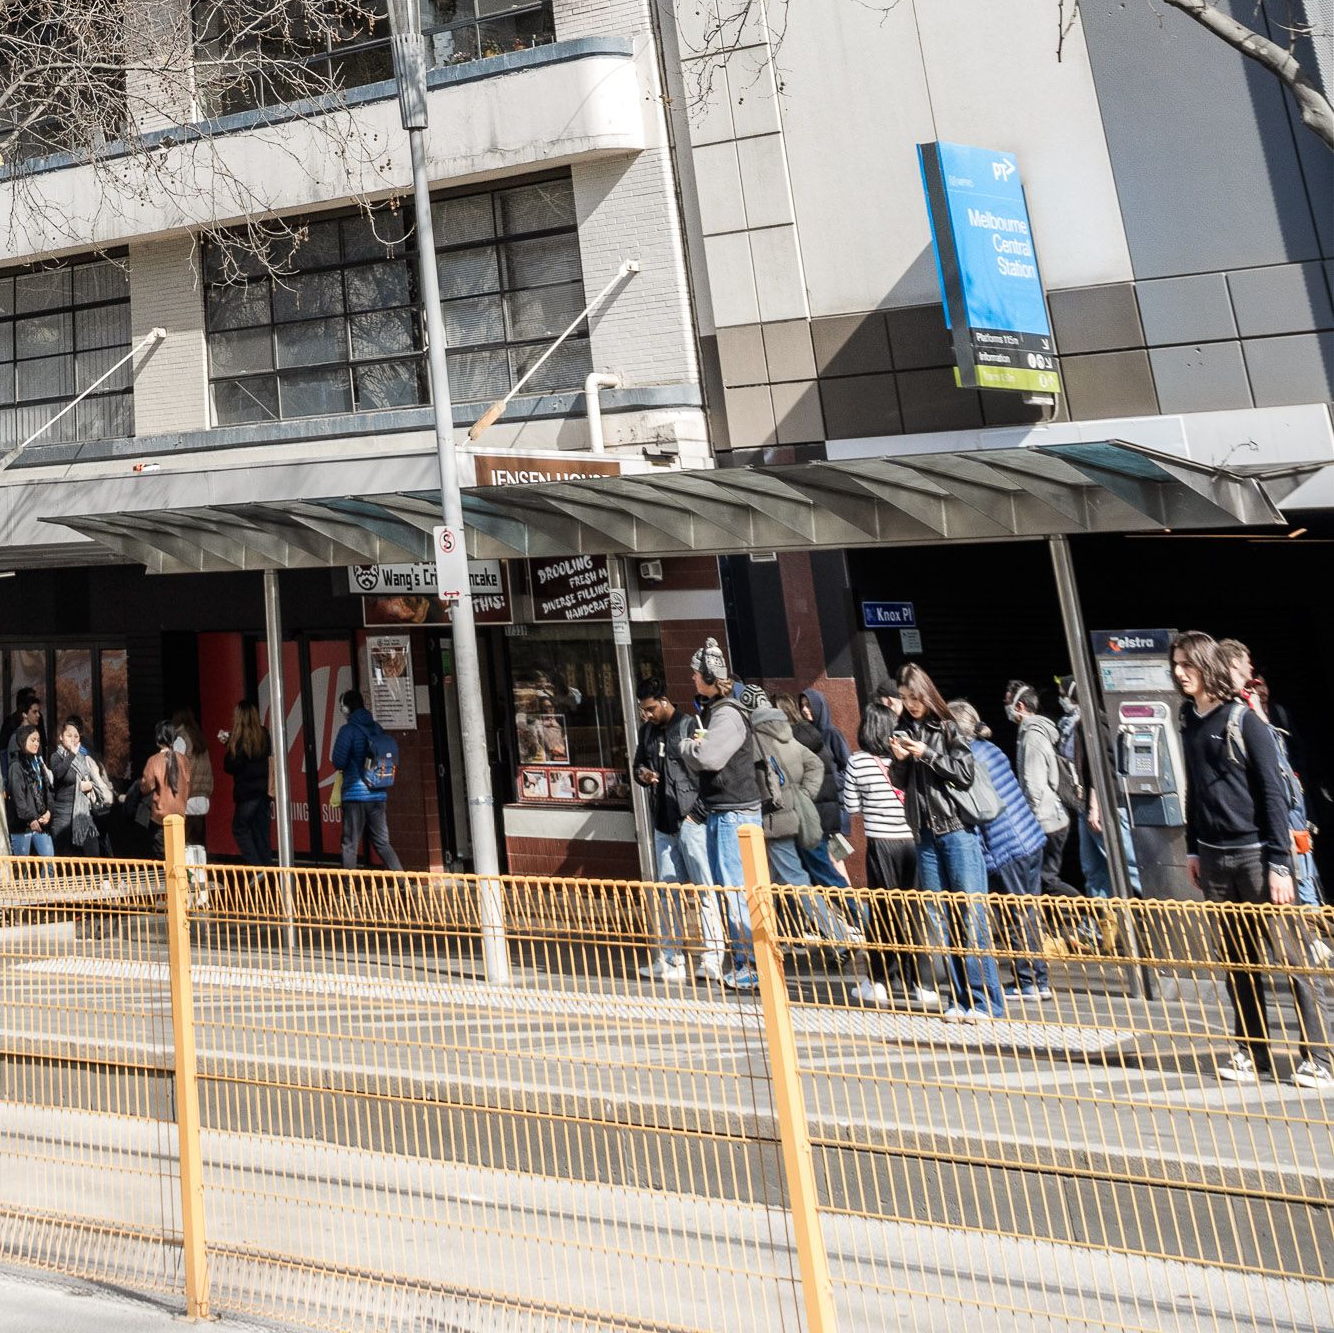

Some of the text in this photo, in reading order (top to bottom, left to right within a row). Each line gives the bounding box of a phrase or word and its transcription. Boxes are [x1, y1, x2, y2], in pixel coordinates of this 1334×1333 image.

[968, 208, 1029, 235] Melbourne
[992, 234, 1032, 257] Central
[997, 256, 1036, 278] Station
[979, 352, 1011, 363] Information
[382, 568, 420, 591] Wang's
[538, 555, 593, 584] DROOLING
[569, 572, 597, 588] FRESH
[542, 594, 576, 614] DIVERSE
[876, 607, 913, 622] Knox Pl
[1108, 636, 1154, 653] Telstra
